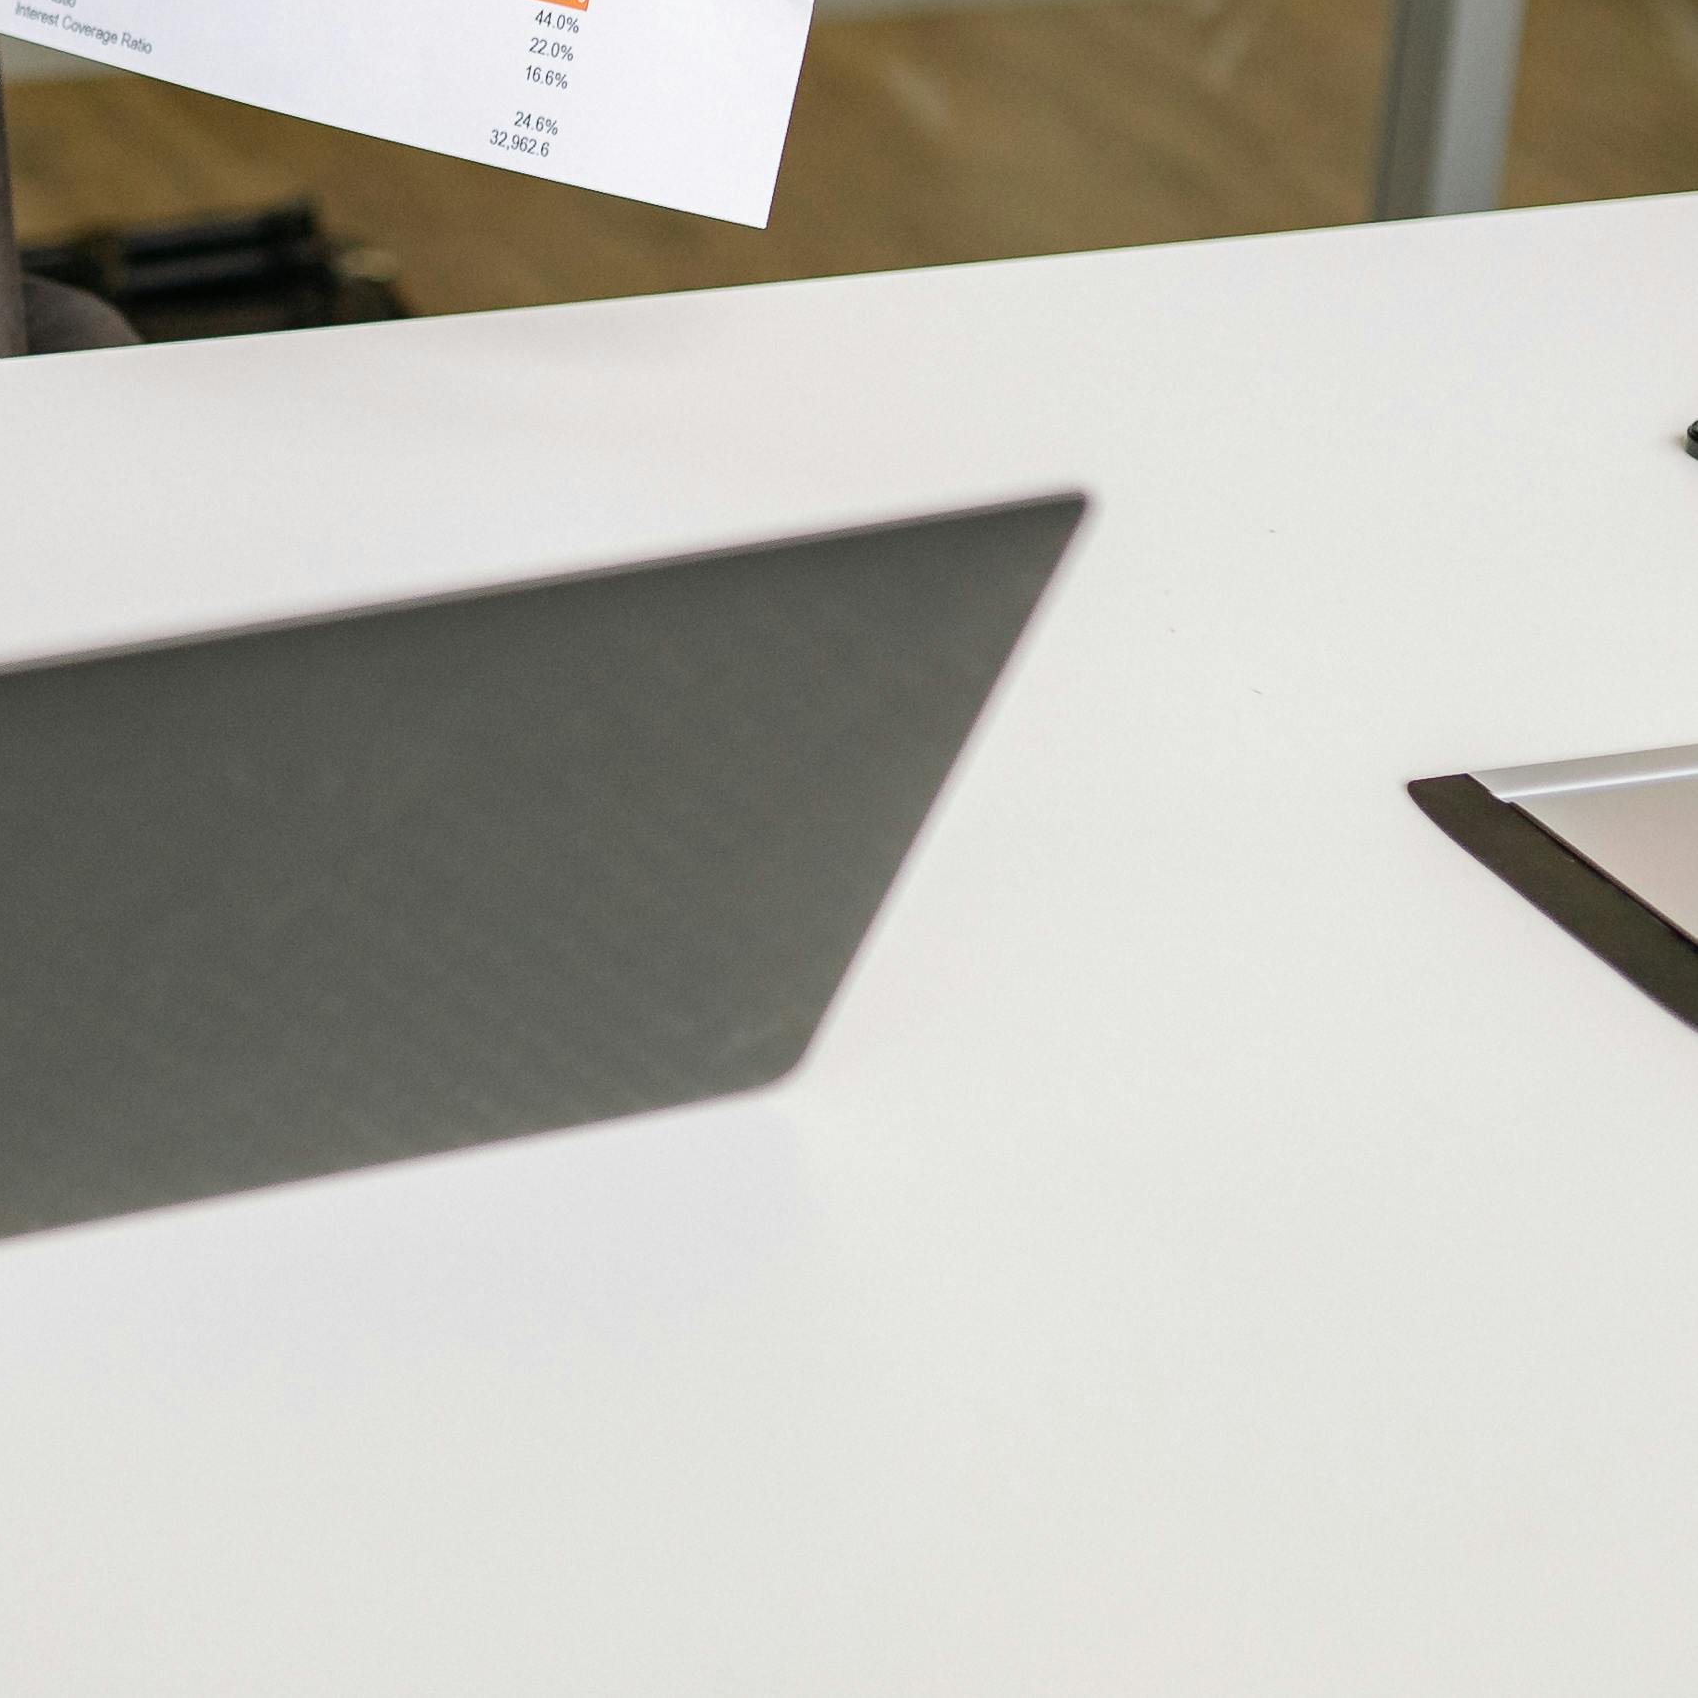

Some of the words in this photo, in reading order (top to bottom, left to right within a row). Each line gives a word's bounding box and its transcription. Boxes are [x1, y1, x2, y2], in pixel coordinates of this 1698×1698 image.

[15, 2, 59, 28] Interest
[62, 15, 118, 46] Coverage
[121, 32, 153, 55] Ratio
[534, 10, 580, 34] 44.0%
[529, 37, 574, 61] 22.0%
[525, 65, 568, 90] 16.6%
[513, 110, 559, 136] 24.6%
[489, 129, 550, 158] 32,962.6
